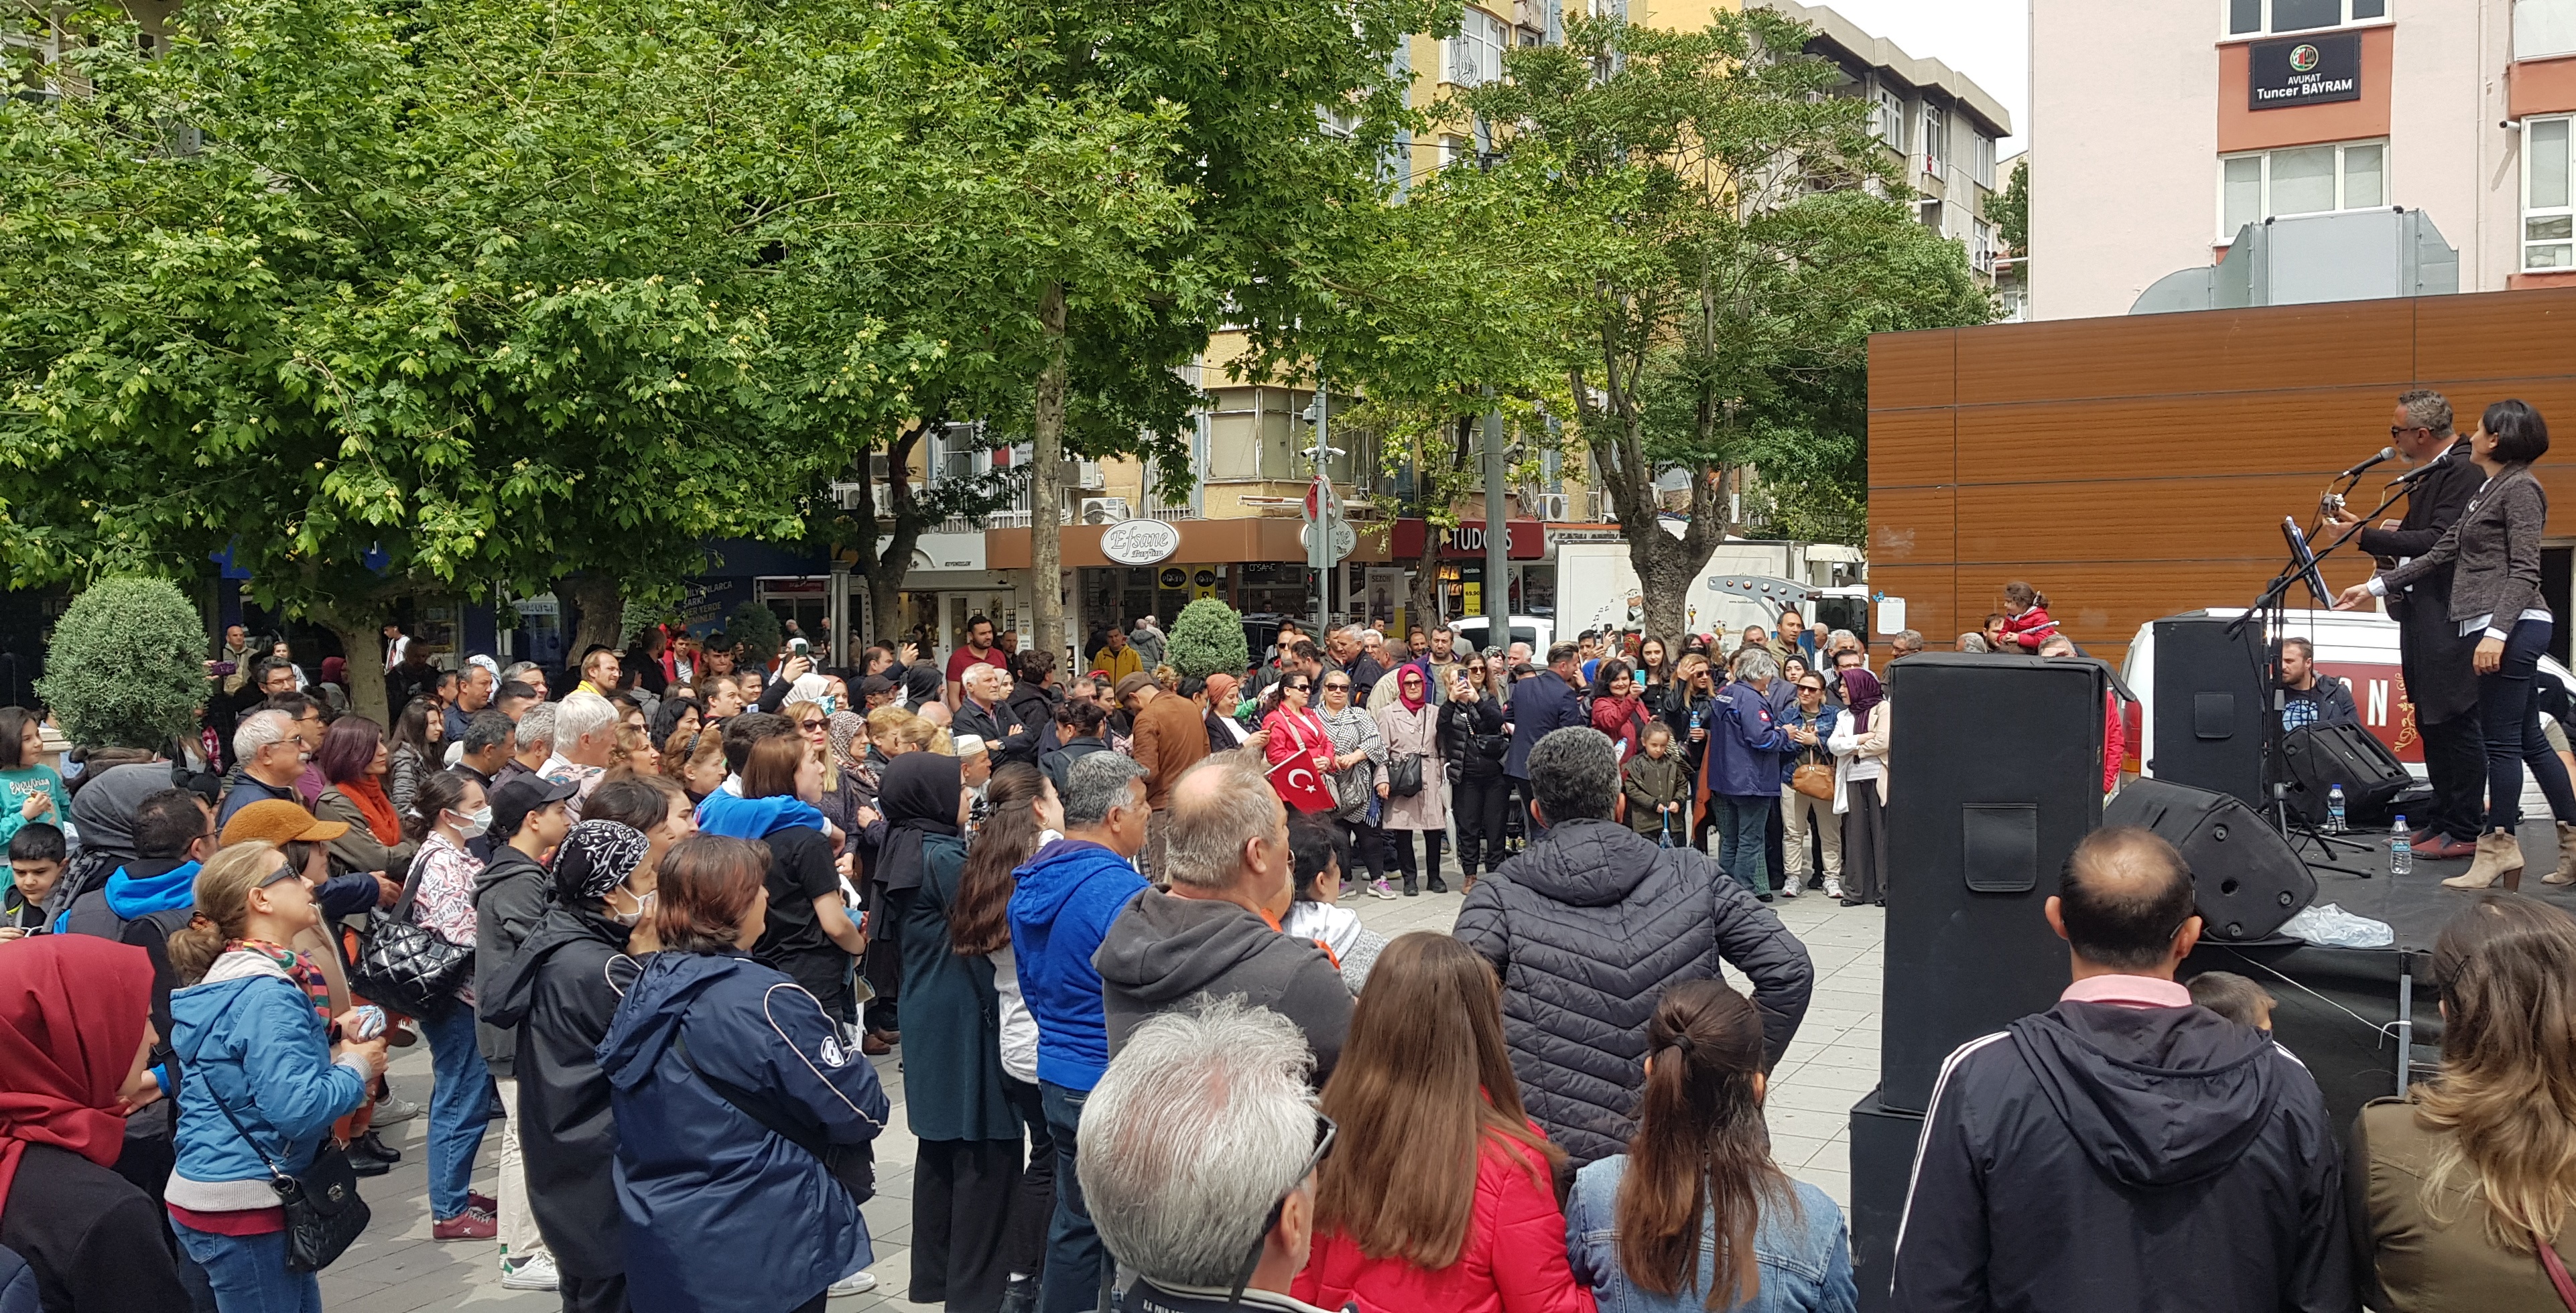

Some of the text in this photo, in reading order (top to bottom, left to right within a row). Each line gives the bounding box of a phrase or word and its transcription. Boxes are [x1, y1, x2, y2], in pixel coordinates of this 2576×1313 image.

[2256, 78, 2353, 99] Tuncer BAYRAM
[2287, 73, 2321, 85] AVUKAT
[1110, 526, 1168, 557] Efsane
[1450, 527, 1512, 551] TUDS
[9, 778, 50, 795] Everything
